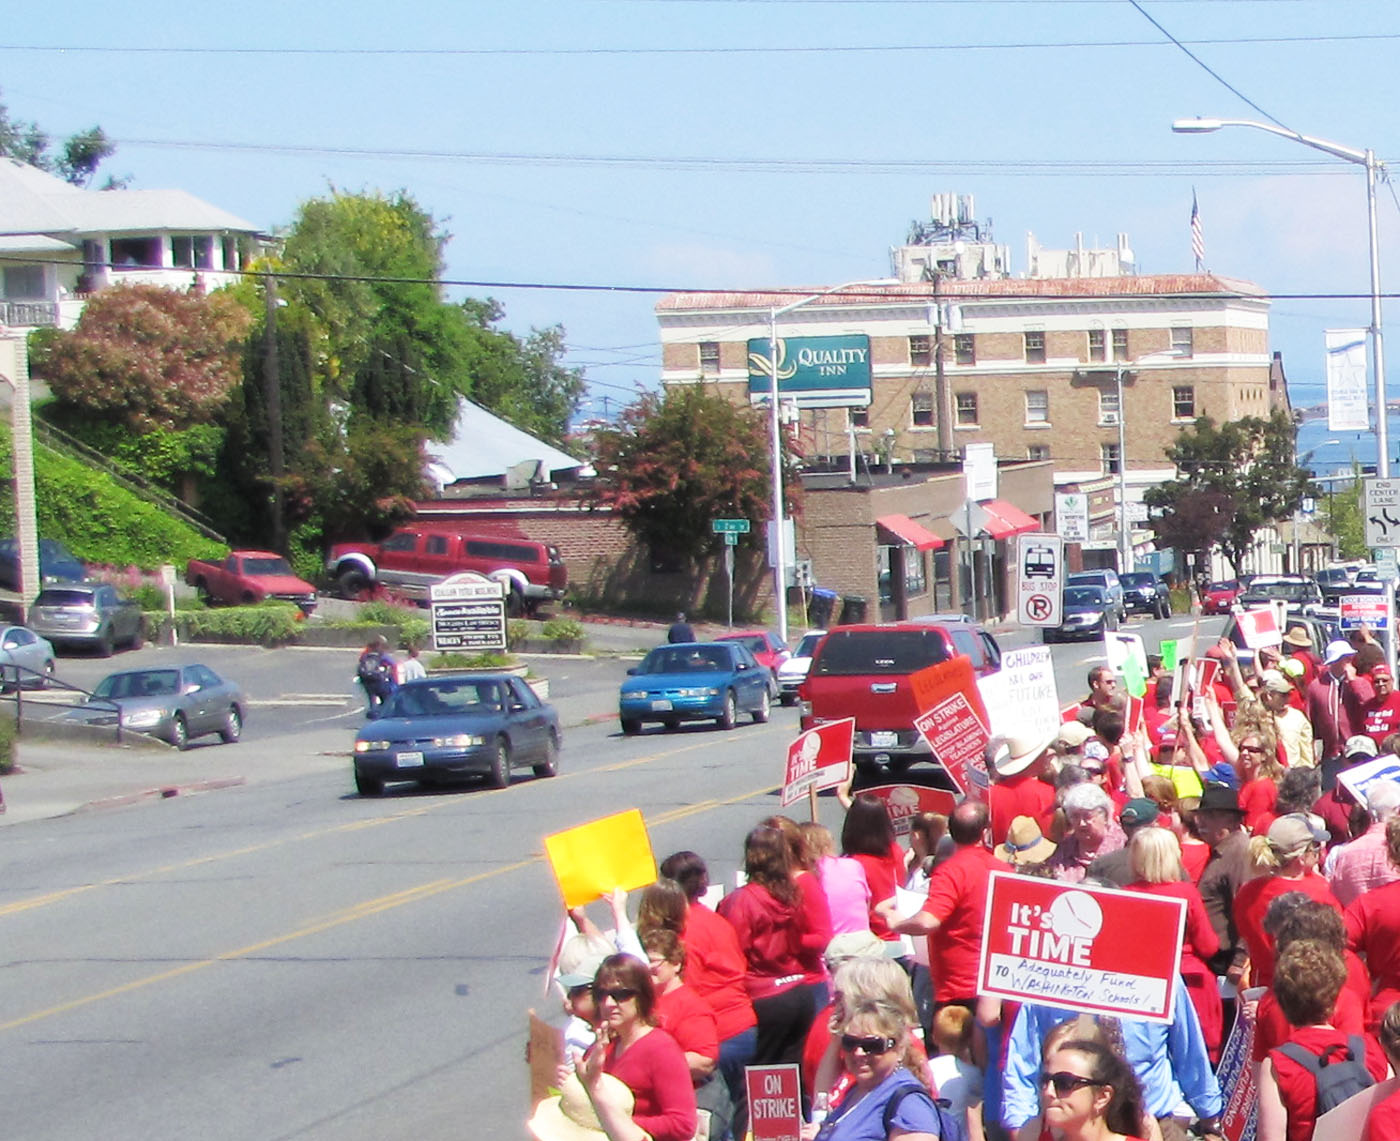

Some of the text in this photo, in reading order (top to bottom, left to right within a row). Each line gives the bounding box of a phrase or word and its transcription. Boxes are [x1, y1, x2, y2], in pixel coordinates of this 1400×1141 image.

[798, 348, 867, 367] QUALITY
[820, 365, 847, 376] INN
[1369, 489, 1398, 497] CENTER
[1021, 581, 1058, 592] BUS STOP
[1005, 651, 1050, 669] CHILDREN
[919, 698, 967, 732] ON STRIKE
[931, 716, 976, 748] LEGISLATURE
[790, 756, 817, 782] TIME
[1010, 902, 1054, 930] It's
[1007, 926, 1094, 967] TIME
[995, 965, 1010, 977] TO
[1017, 958, 1137, 990] Adequately Fund
[764, 1074, 782, 1094] ON
[754, 1098, 796, 1118] STRIKE
[1225, 1073, 1250, 1128] FUNDING
